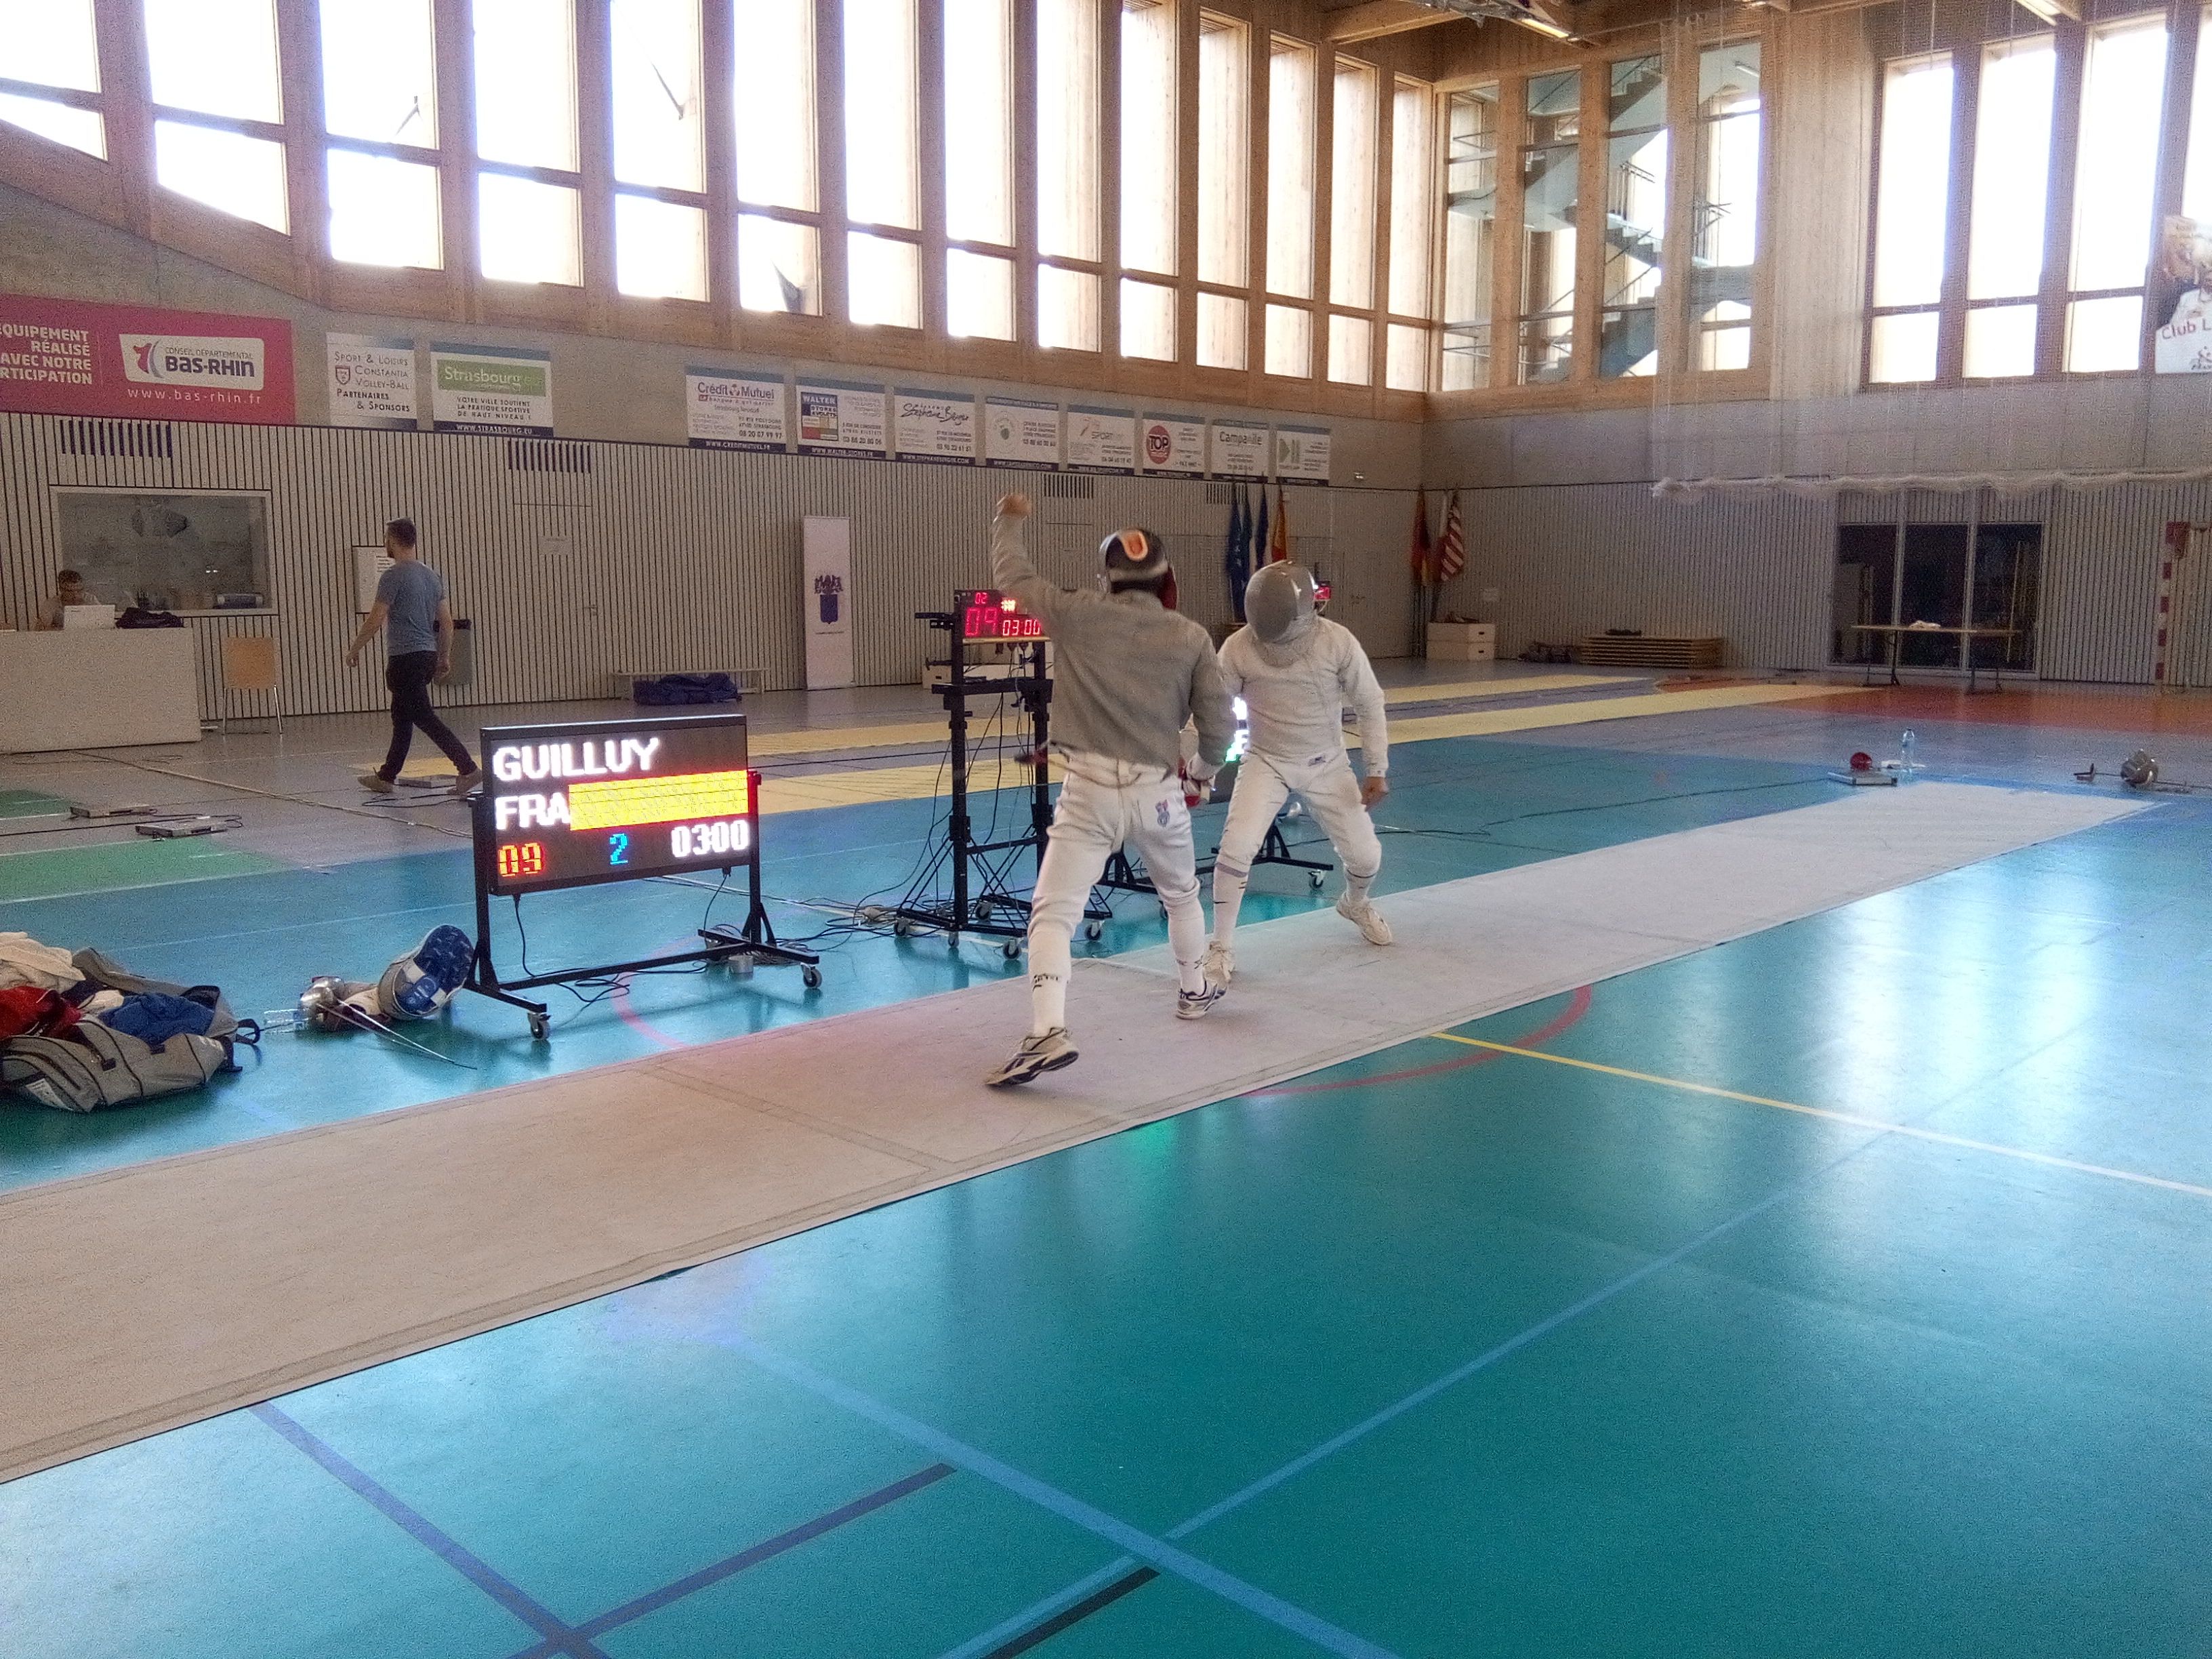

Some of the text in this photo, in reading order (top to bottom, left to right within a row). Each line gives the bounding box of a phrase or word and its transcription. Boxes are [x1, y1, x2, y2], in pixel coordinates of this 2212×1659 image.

[0, 324, 89, 342] QUIPEMENT
[2162, 320, 2196, 340] Club
[31, 340, 90, 356] RÉALISÉ
[1, 353, 91, 370] AVEC NOTRE
[127, 388, 260, 404] www.bas-rhin.fr
[697, 382, 774, 398] Crédit Mutuel
[803, 395, 836, 405] WALTER
[1149, 435, 1169, 450] TOP
[493, 739, 659, 781] GUILLUY
[495, 793, 570, 830] FRA
[498, 842, 542, 877] 09
[609, 833, 628, 865] 2
